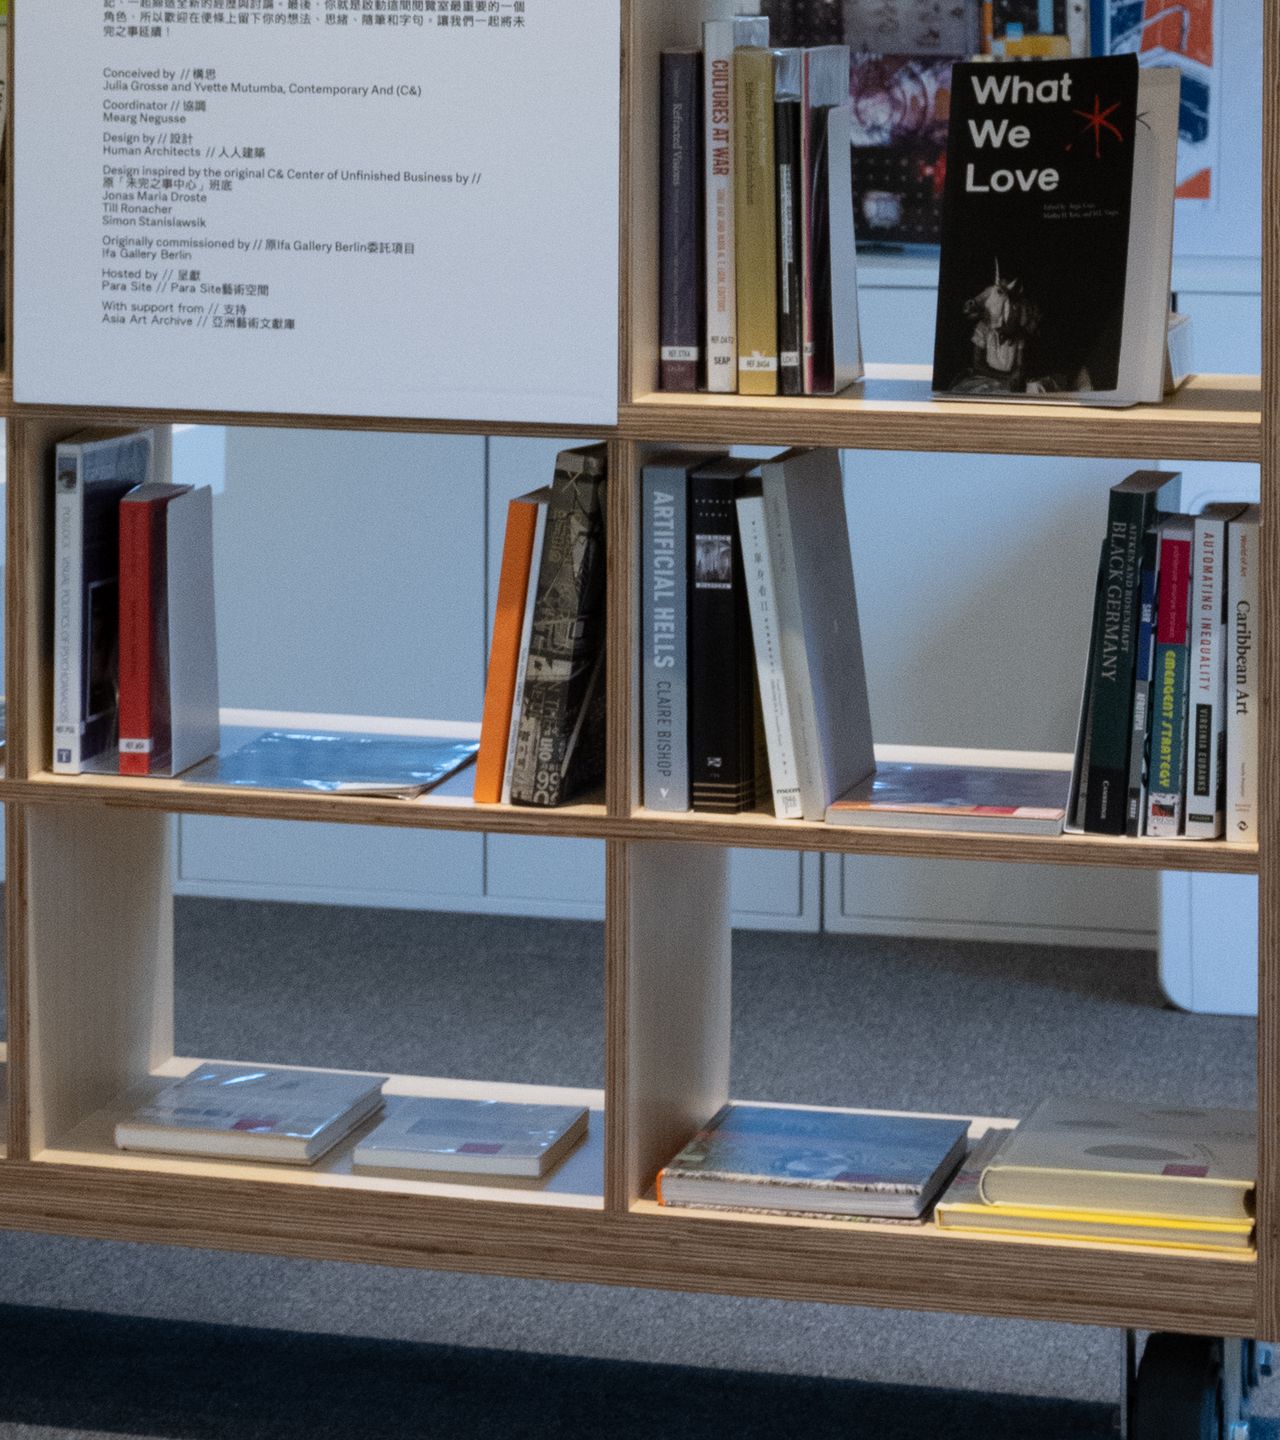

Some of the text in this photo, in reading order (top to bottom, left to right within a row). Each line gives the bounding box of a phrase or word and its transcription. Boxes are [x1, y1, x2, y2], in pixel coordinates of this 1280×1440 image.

[103, 67, 175, 81] Conceived by
[103, 80, 421, 97] Julia Grosse and Yvette Mutumba, Contemporary And (C&)
[970, 70, 1073, 107] What
[102, 99, 167, 110] Coordinator
[103, 112, 186, 125] Mearg Negusse
[710, 59, 730, 176] CULTURES AT WAR
[967, 117, 1031, 149] We
[103, 145, 200, 156] Human Architects
[964, 160, 1060, 193] Love
[102, 190, 206, 202] Jonas Maria Droste
[103, 202, 172, 214] Till Ronacher
[713, 355, 731, 365] SEAP
[651, 490, 675, 668] ARTIFICIAL HELLS
[1100, 520, 1128, 682] BLACK GERMANY
[1197, 531, 1215, 691] AUTOMATING INEQUALITY
[1233, 599, 1252, 716] Caribbean Art
[655, 680, 672, 777] CLAIRE BISHOP
[1157, 649, 1177, 788] EMERGENT STRATEGY
[1195, 707, 1210, 792] VIRGINIA EUBANKS
